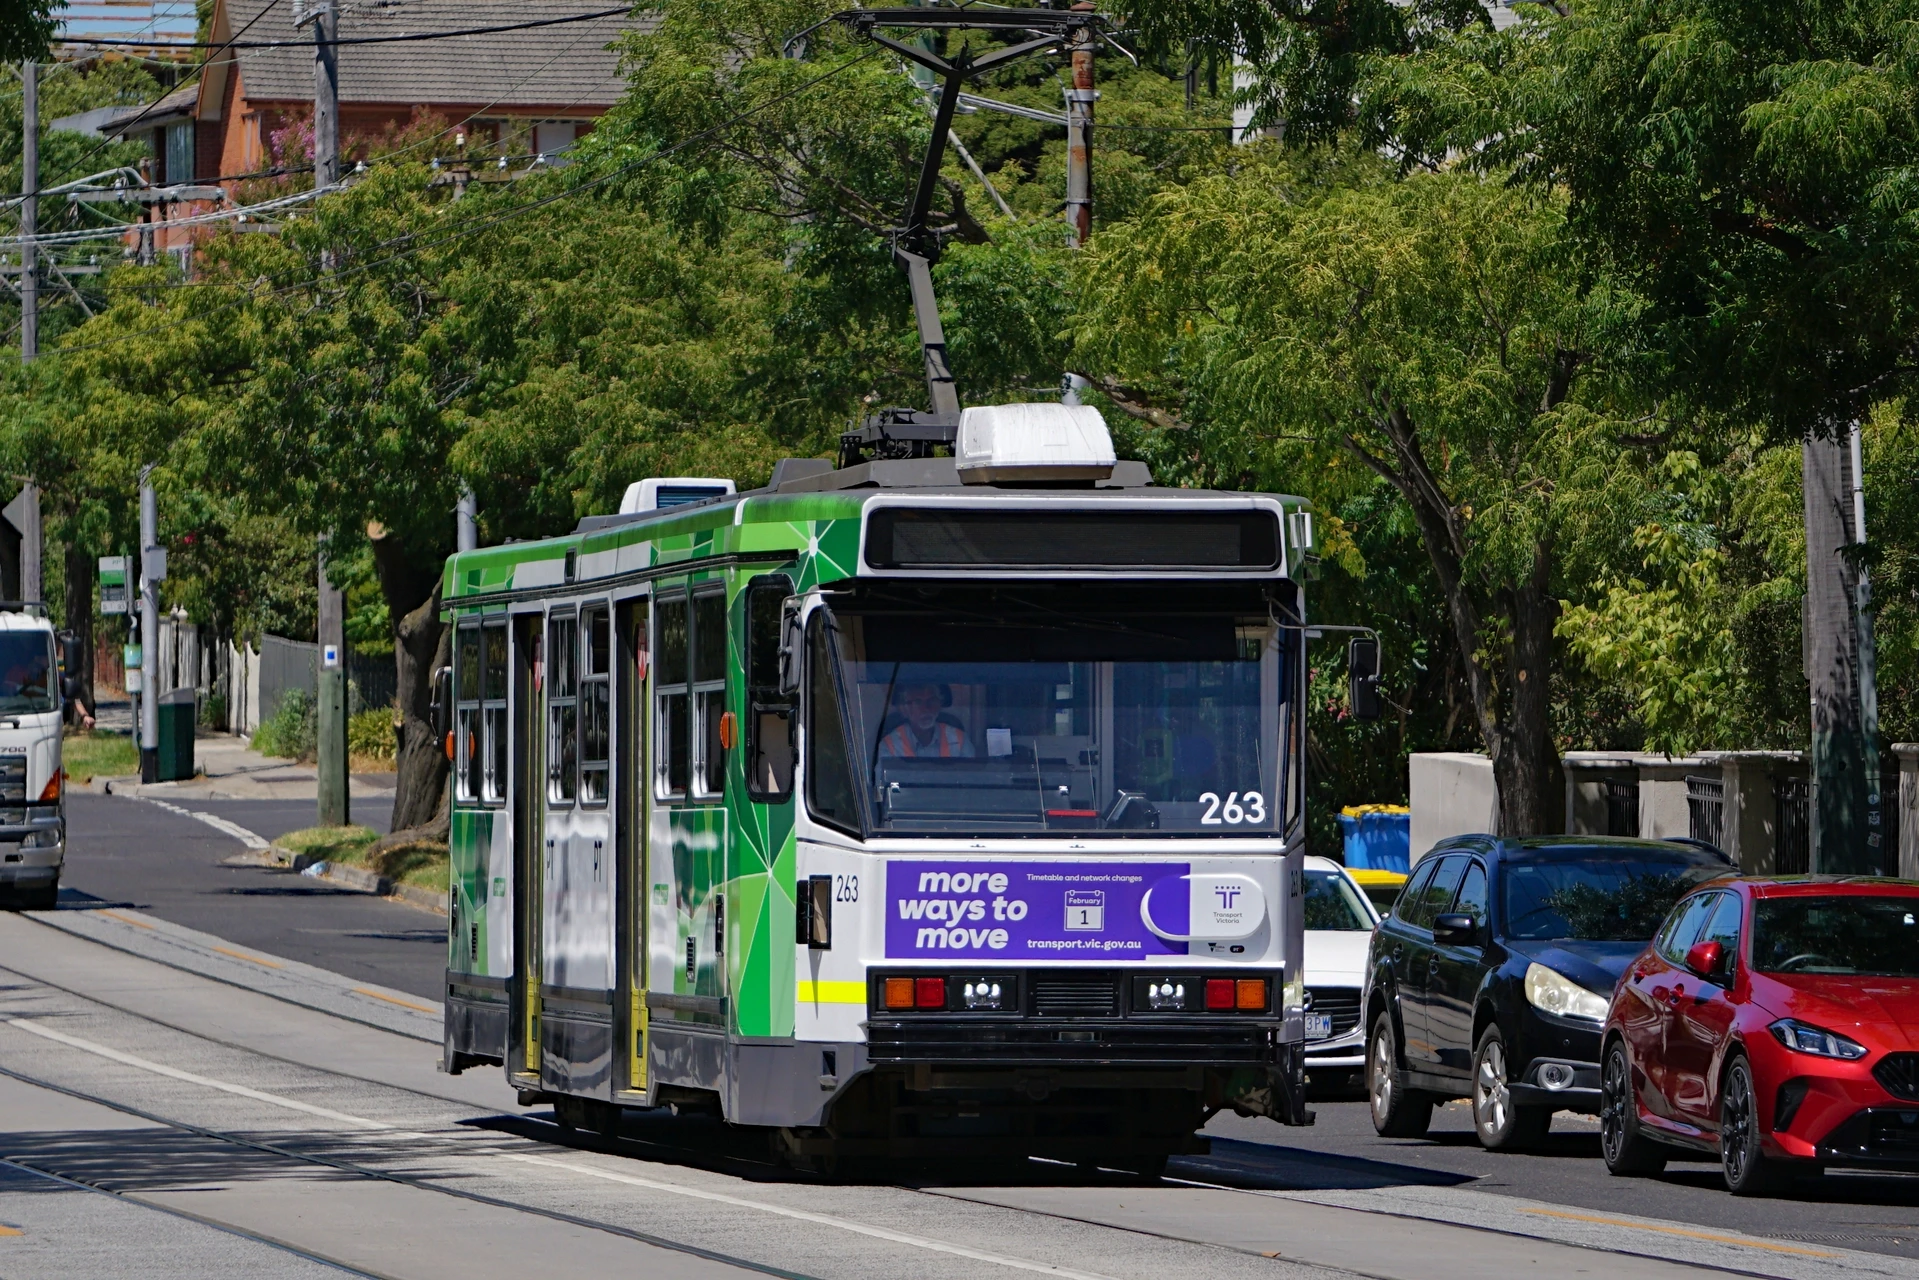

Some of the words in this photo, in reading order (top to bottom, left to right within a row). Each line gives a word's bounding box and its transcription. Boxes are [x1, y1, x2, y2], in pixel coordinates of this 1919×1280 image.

[1199, 791, 1266, 824] 263
[836, 875, 859, 902] 263
[918, 872, 1009, 893] more
[1080, 874, 1111, 882] network
[1111, 874, 1143, 883] changes
[898, 899, 986, 927] ways
[992, 896, 1028, 920] to
[1069, 897, 1101, 905] February
[1080, 910, 1089, 925] 1
[916, 927, 1009, 949] move
[1027, 939, 1141, 950] transport.vic.gov.au
